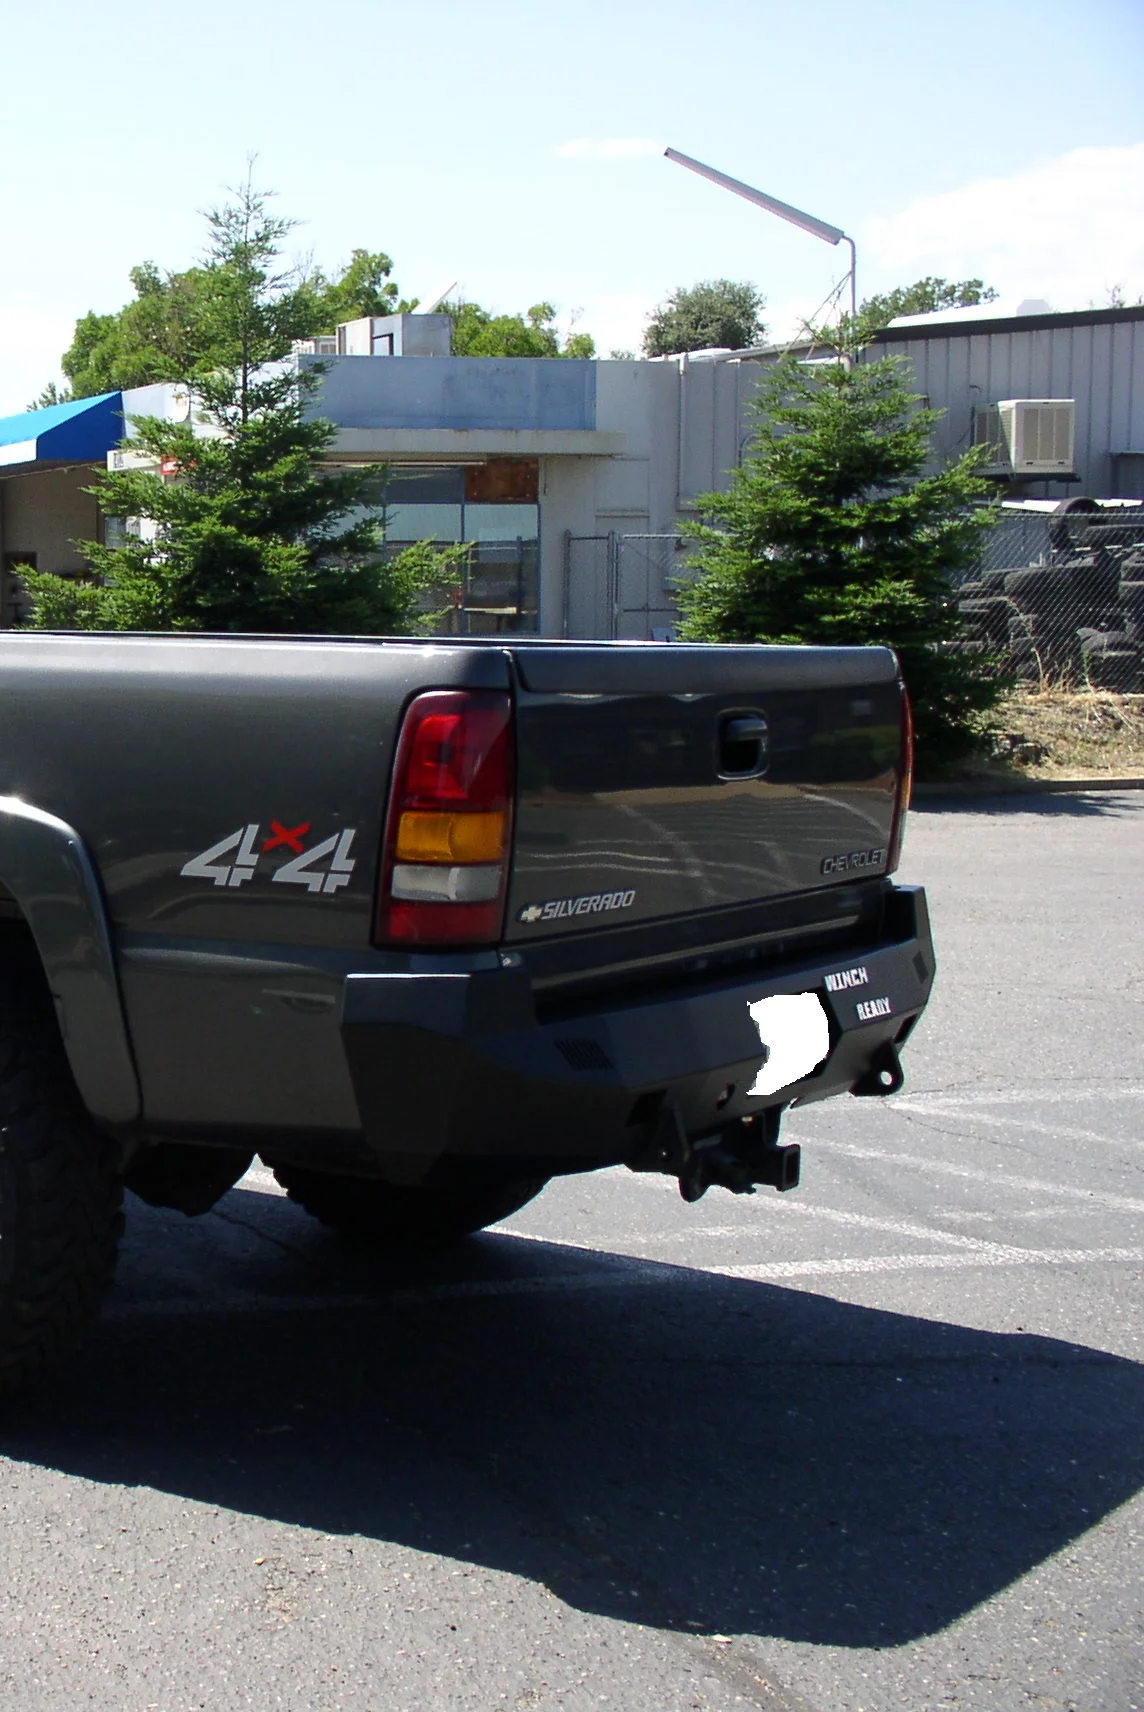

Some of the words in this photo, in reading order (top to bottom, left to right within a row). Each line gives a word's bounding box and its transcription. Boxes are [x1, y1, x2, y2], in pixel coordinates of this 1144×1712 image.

[822, 849, 885, 875] CHEVROLET
[541, 889, 637, 921] SILVERADO
[824, 966, 870, 993] WINCH
[856, 997, 892, 1021] READY
